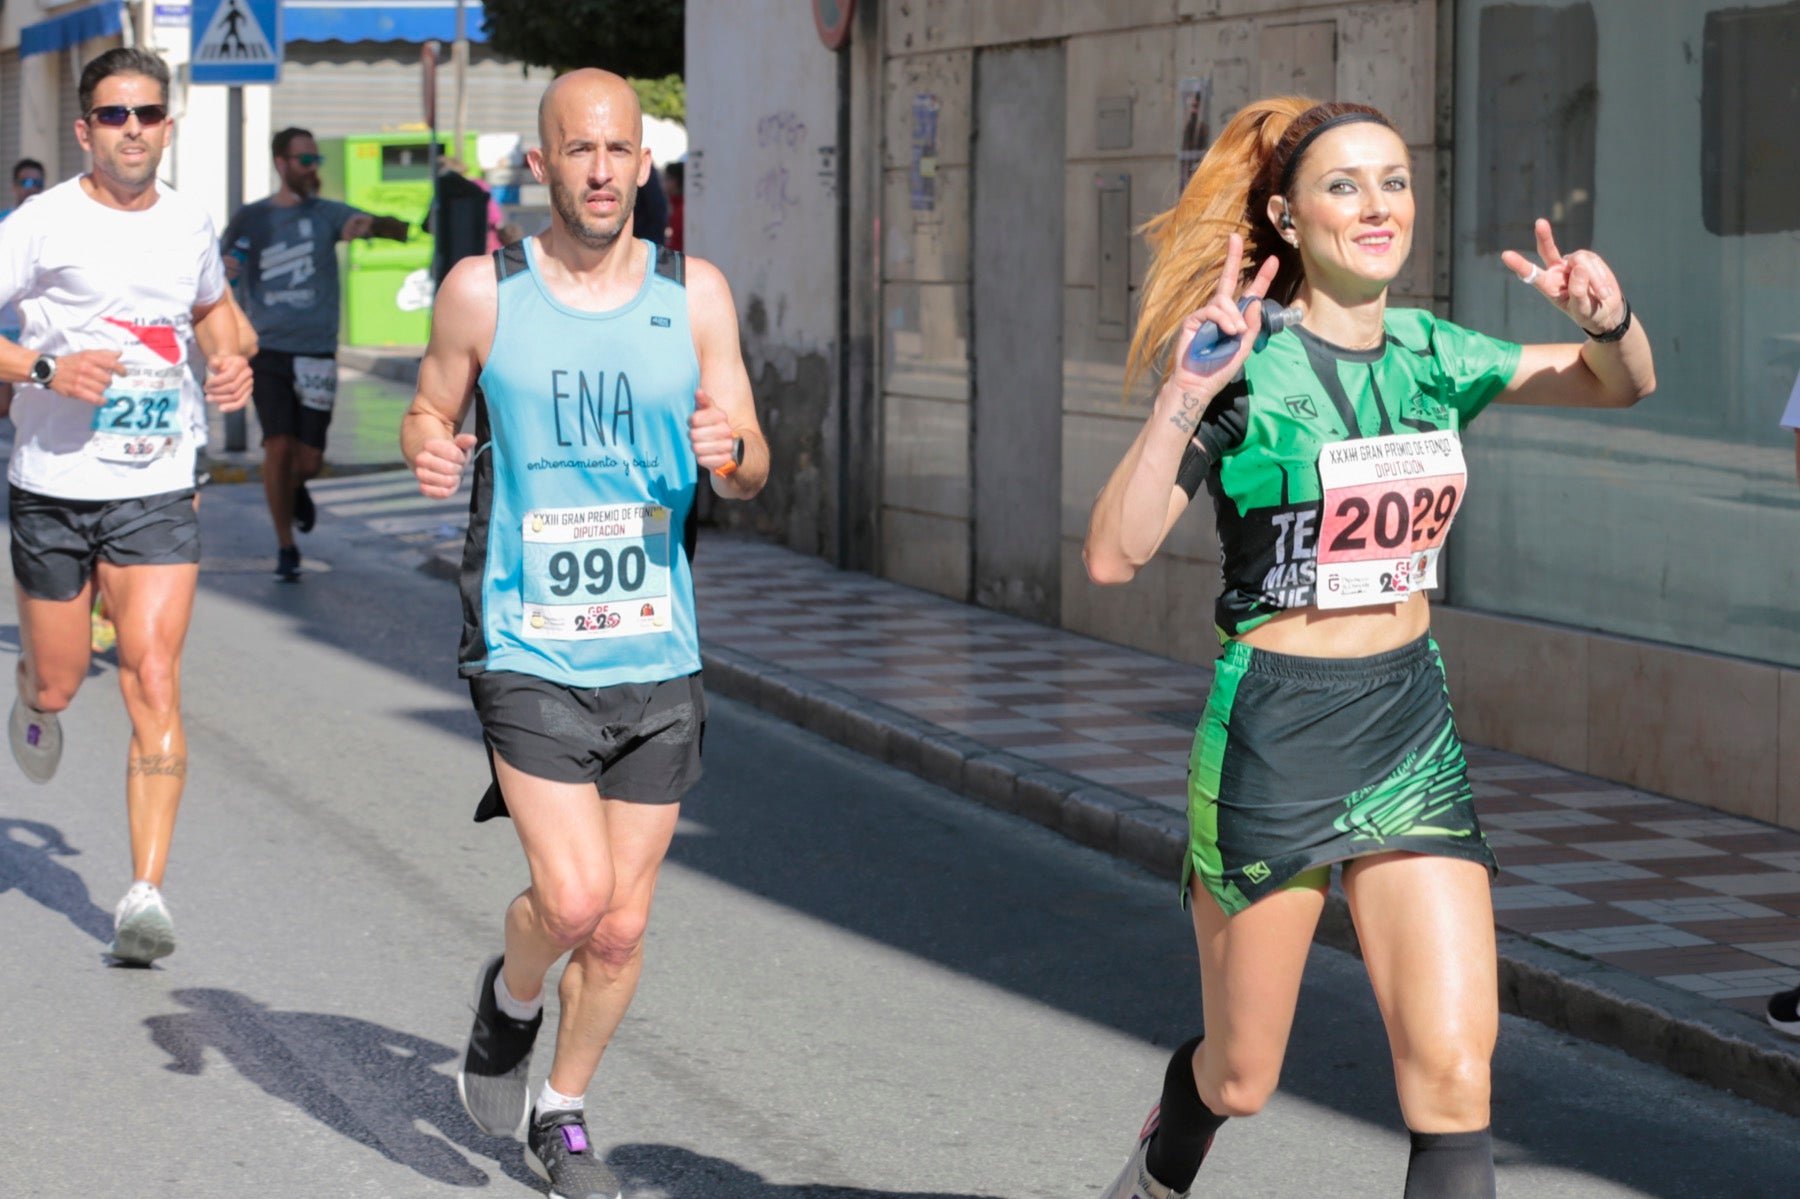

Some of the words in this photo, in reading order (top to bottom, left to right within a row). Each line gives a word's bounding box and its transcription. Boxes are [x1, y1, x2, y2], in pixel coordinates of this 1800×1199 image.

[110, 396, 170, 430] 232
[552, 370, 635, 447] ENA
[526, 455, 618, 471] entrenamiento
[622, 460, 631, 477] y
[1360, 444, 1384, 461] GRAN
[1413, 441, 1425, 456] DE
[562, 511, 587, 526] GRAN
[587, 509, 619, 523] PREMIO
[621, 507, 632, 520] DE
[1329, 485, 1457, 552] 2029
[1272, 509, 1317, 564] TE
[549, 545, 646, 597] 990
[1262, 561, 1316, 591] MAS
